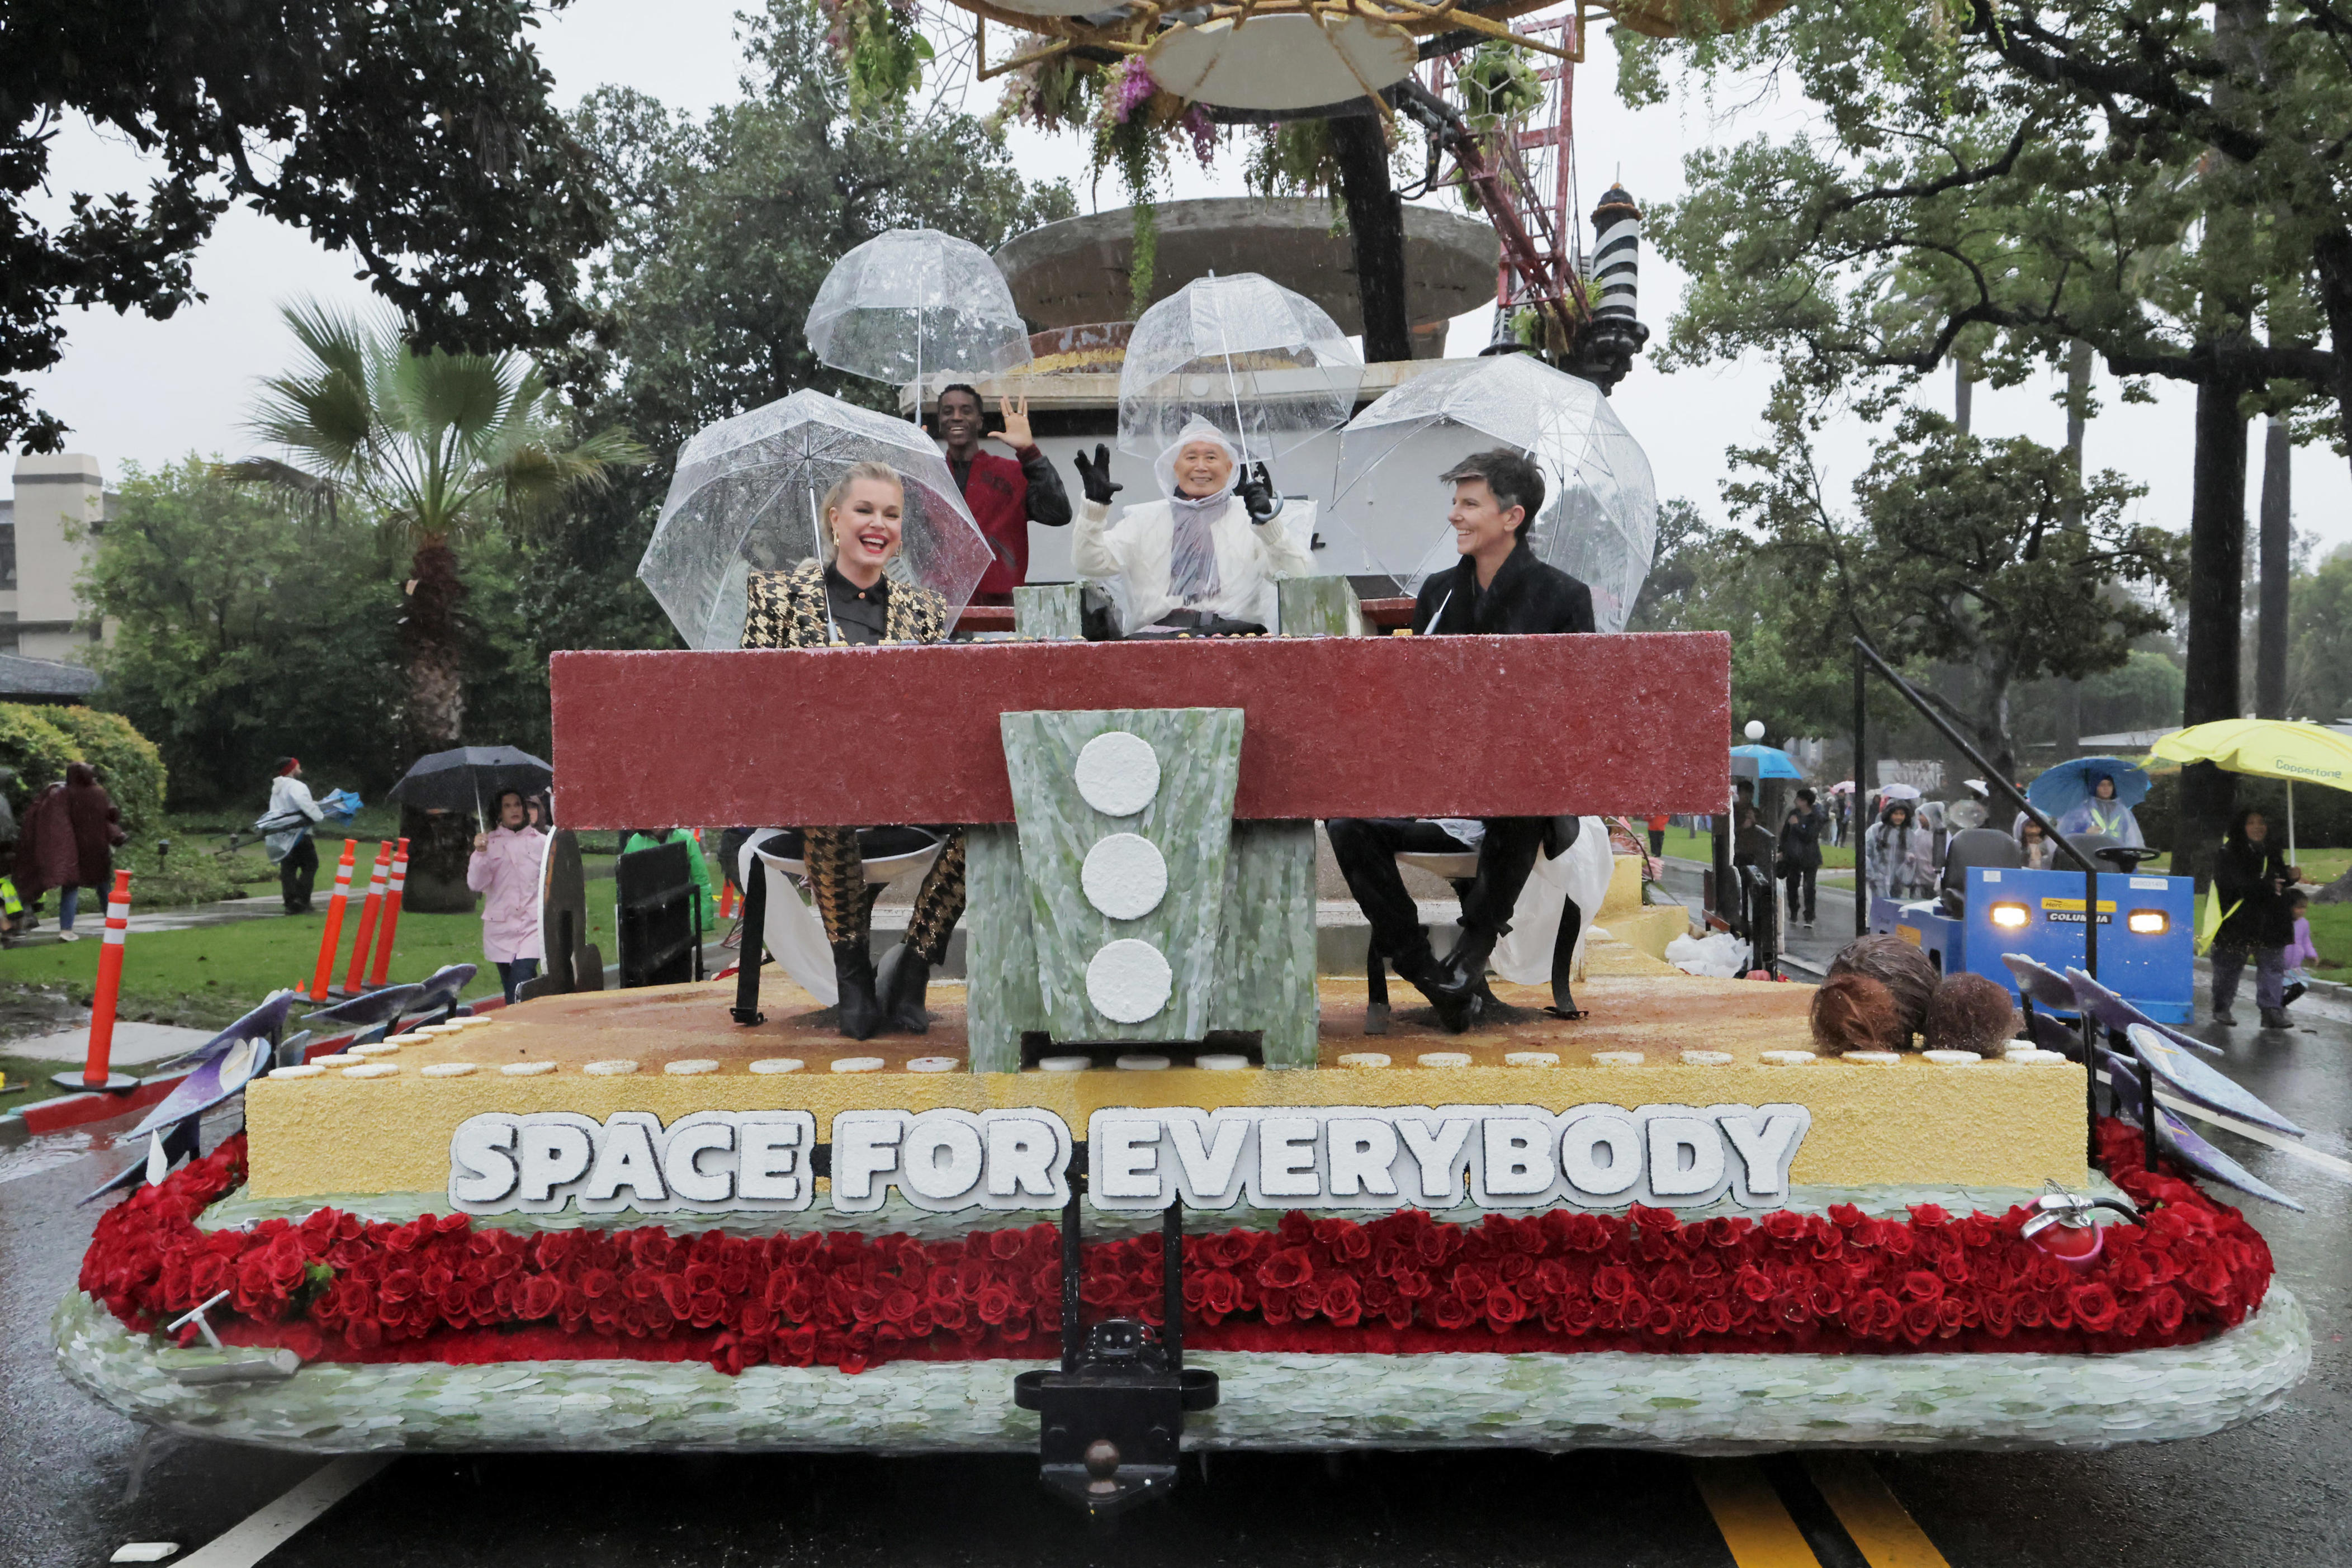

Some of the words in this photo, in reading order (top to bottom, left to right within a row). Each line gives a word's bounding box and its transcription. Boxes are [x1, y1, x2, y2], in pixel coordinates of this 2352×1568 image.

[2276, 759, 2341, 778] Coppertone
[2050, 913, 2108, 923] COLUMIA
[455, 1121, 802, 1203] SPACE
[839, 1119, 1059, 1201] FOR
[1100, 1116, 1801, 1198] EVERYBODY
